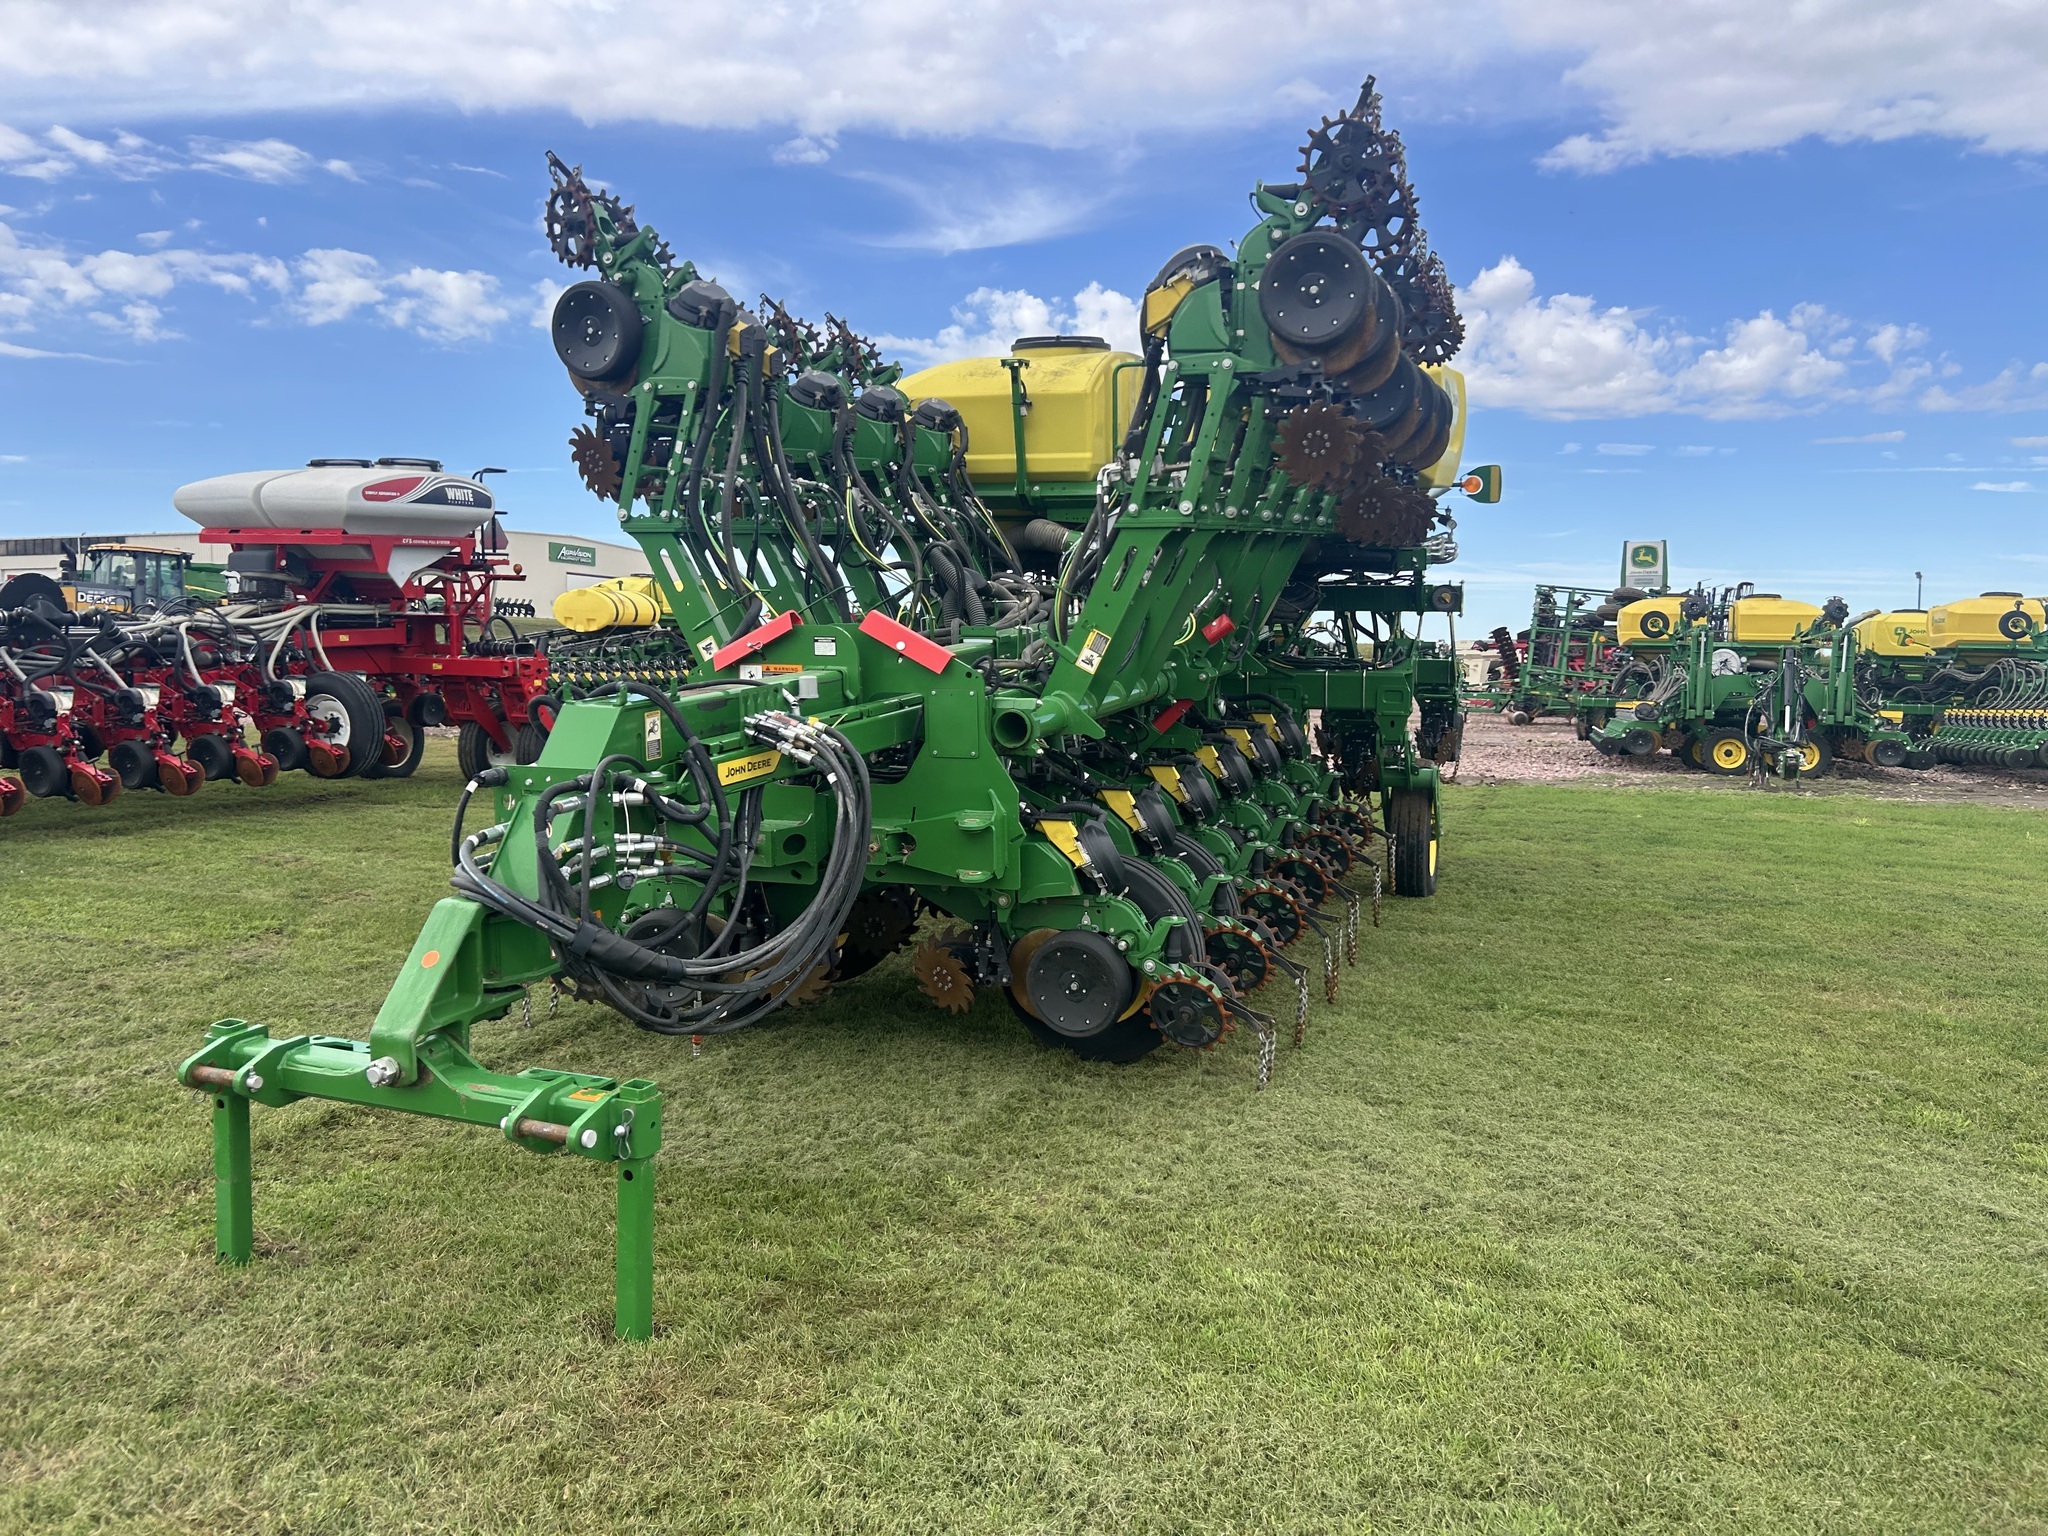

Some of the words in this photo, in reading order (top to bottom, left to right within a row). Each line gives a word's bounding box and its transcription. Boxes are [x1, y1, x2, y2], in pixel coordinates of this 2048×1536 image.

[445, 487, 474, 502] WHITE
[77, 591, 117, 605] DEERE
[725, 765, 746, 778] JOHN
[747, 758, 772, 772] DEERE
